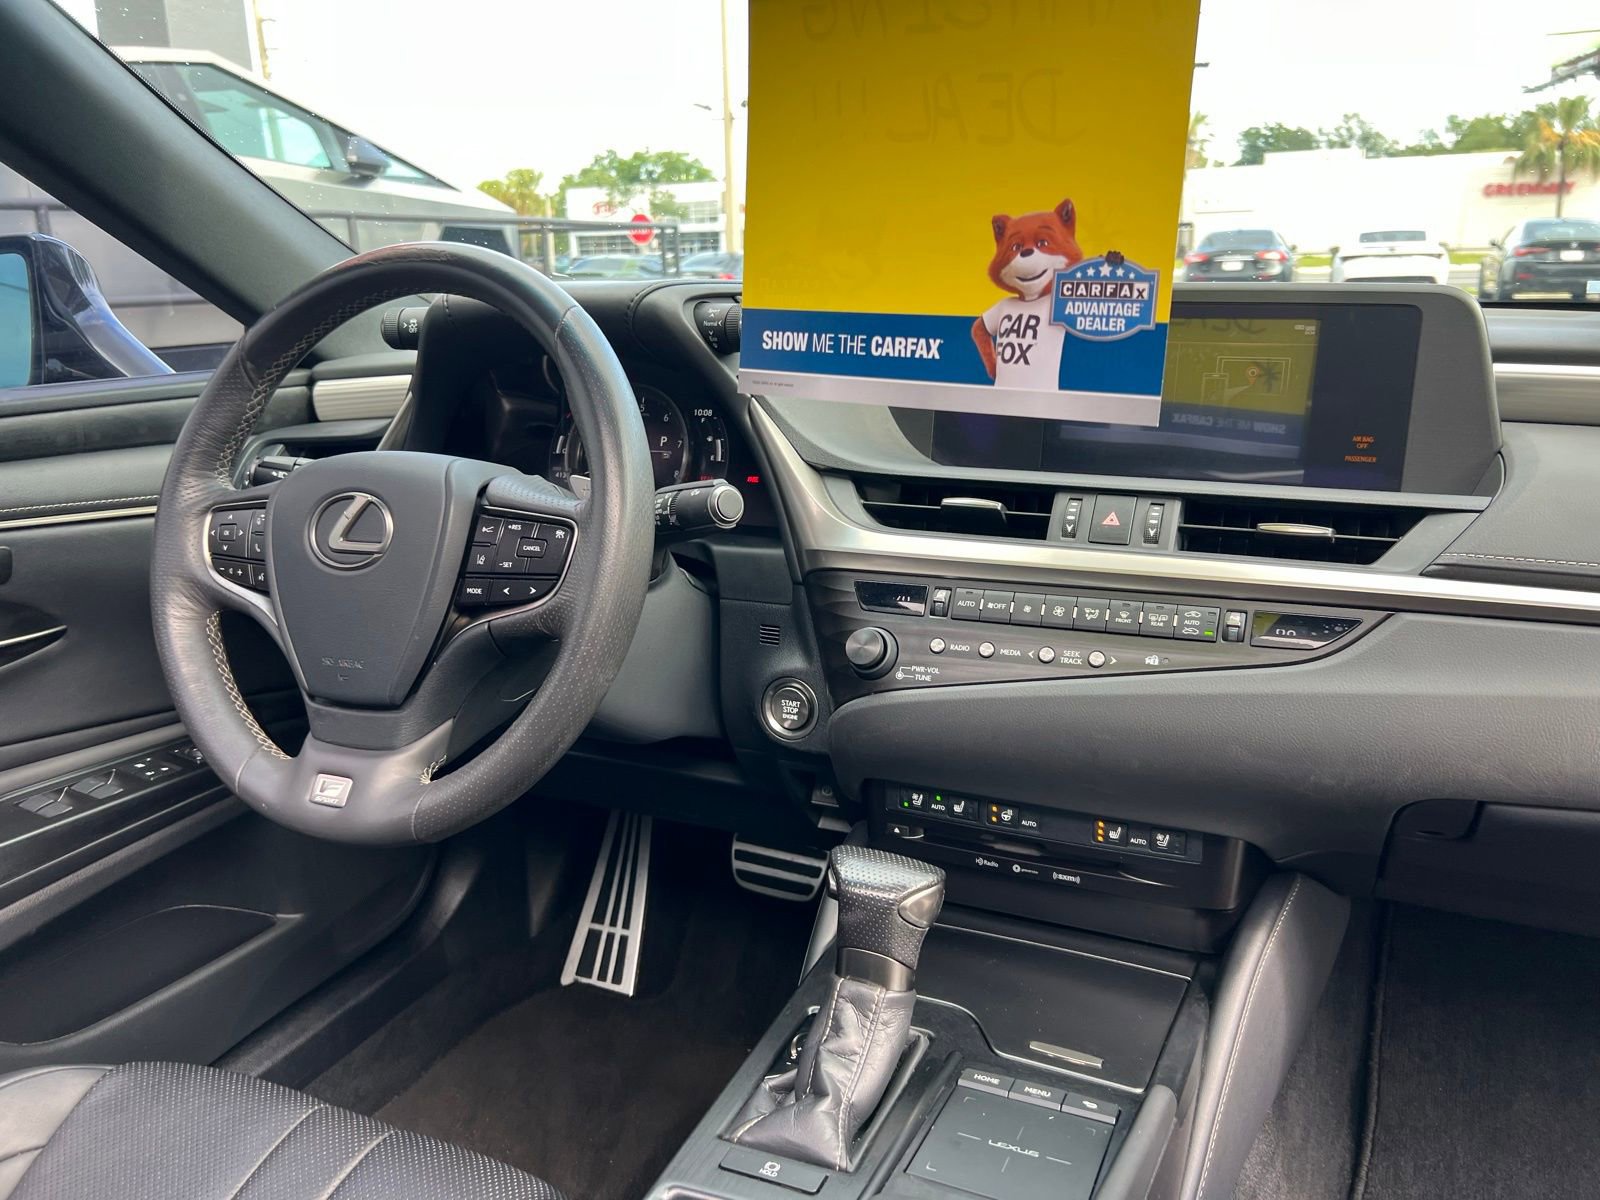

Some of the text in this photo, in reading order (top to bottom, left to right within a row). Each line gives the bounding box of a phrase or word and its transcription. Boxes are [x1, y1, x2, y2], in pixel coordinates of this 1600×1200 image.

[1062, 283, 1146, 299] CARFAX
[1065, 301, 1141, 317] ADVANTAGE
[998, 313, 1041, 340] CAR
[1076, 316, 1126, 332] DEALER
[762, 330, 941, 360] SHOW ME THE CARFAX
[694, 409, 713, 417] 10:08
[660, 436, 668, 447] P
[466, 587, 483, 595] MODE
[957, 599, 976, 608] AUTO
[993, 602, 1007, 610] OFF
[950, 643, 970, 652] RADIO
[1000, 648, 1022, 657] MEDIA
[1063, 650, 1081, 658] SEEK
[1060, 657, 1083, 665] TRACK
[911, 665, 940, 675] PWR-VOL
[914, 674, 932, 682] TUNE
[781, 699, 801, 708] START
[782, 706, 799, 714] STOP
[782, 713, 798, 721] ENGINE
[931, 803, 946, 811] AUTO
[1021, 819, 1037, 828] AUTO
[1130, 837, 1147, 846] AUTO
[973, 1073, 1000, 1086] HOME
[1024, 1086, 1052, 1098] MENU
[988, 1138, 1040, 1158] LEXUS
